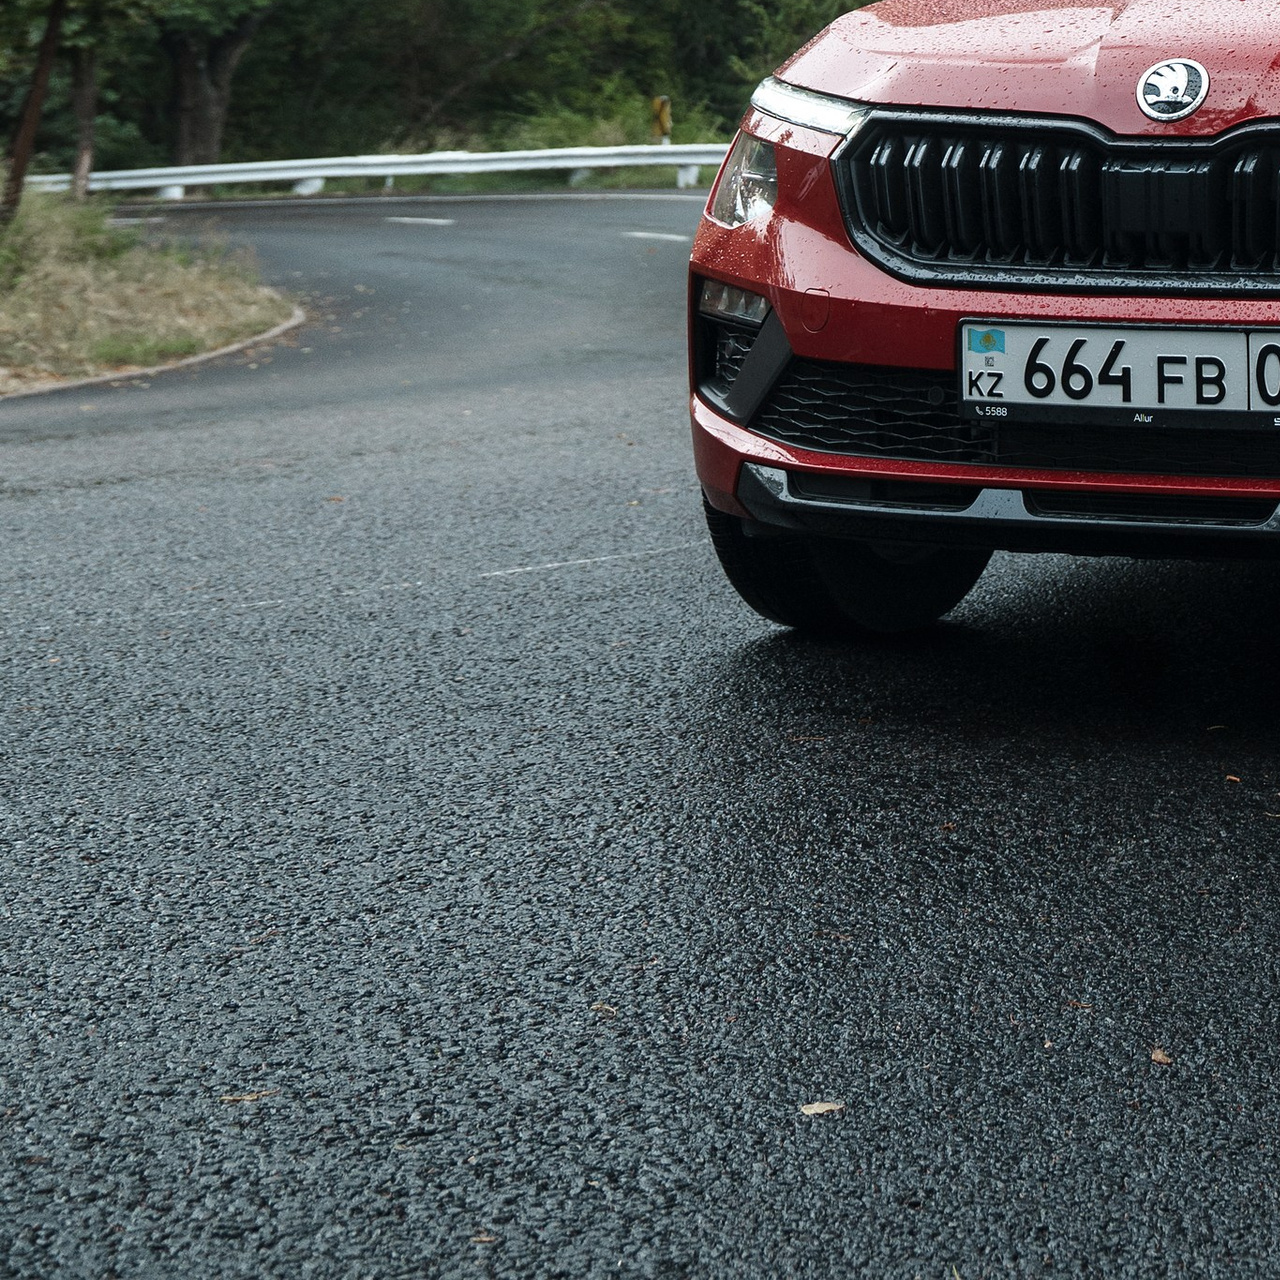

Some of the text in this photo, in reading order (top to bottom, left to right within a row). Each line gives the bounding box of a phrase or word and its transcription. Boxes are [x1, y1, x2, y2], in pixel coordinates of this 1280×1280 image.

[1023, 336, 1132, 403] 664
[1156, 354, 1227, 405] FB
[967, 370, 1004, 398] KZ
[985, 406, 1008, 417] 5588
[1133, 413, 1154, 423] Allur
